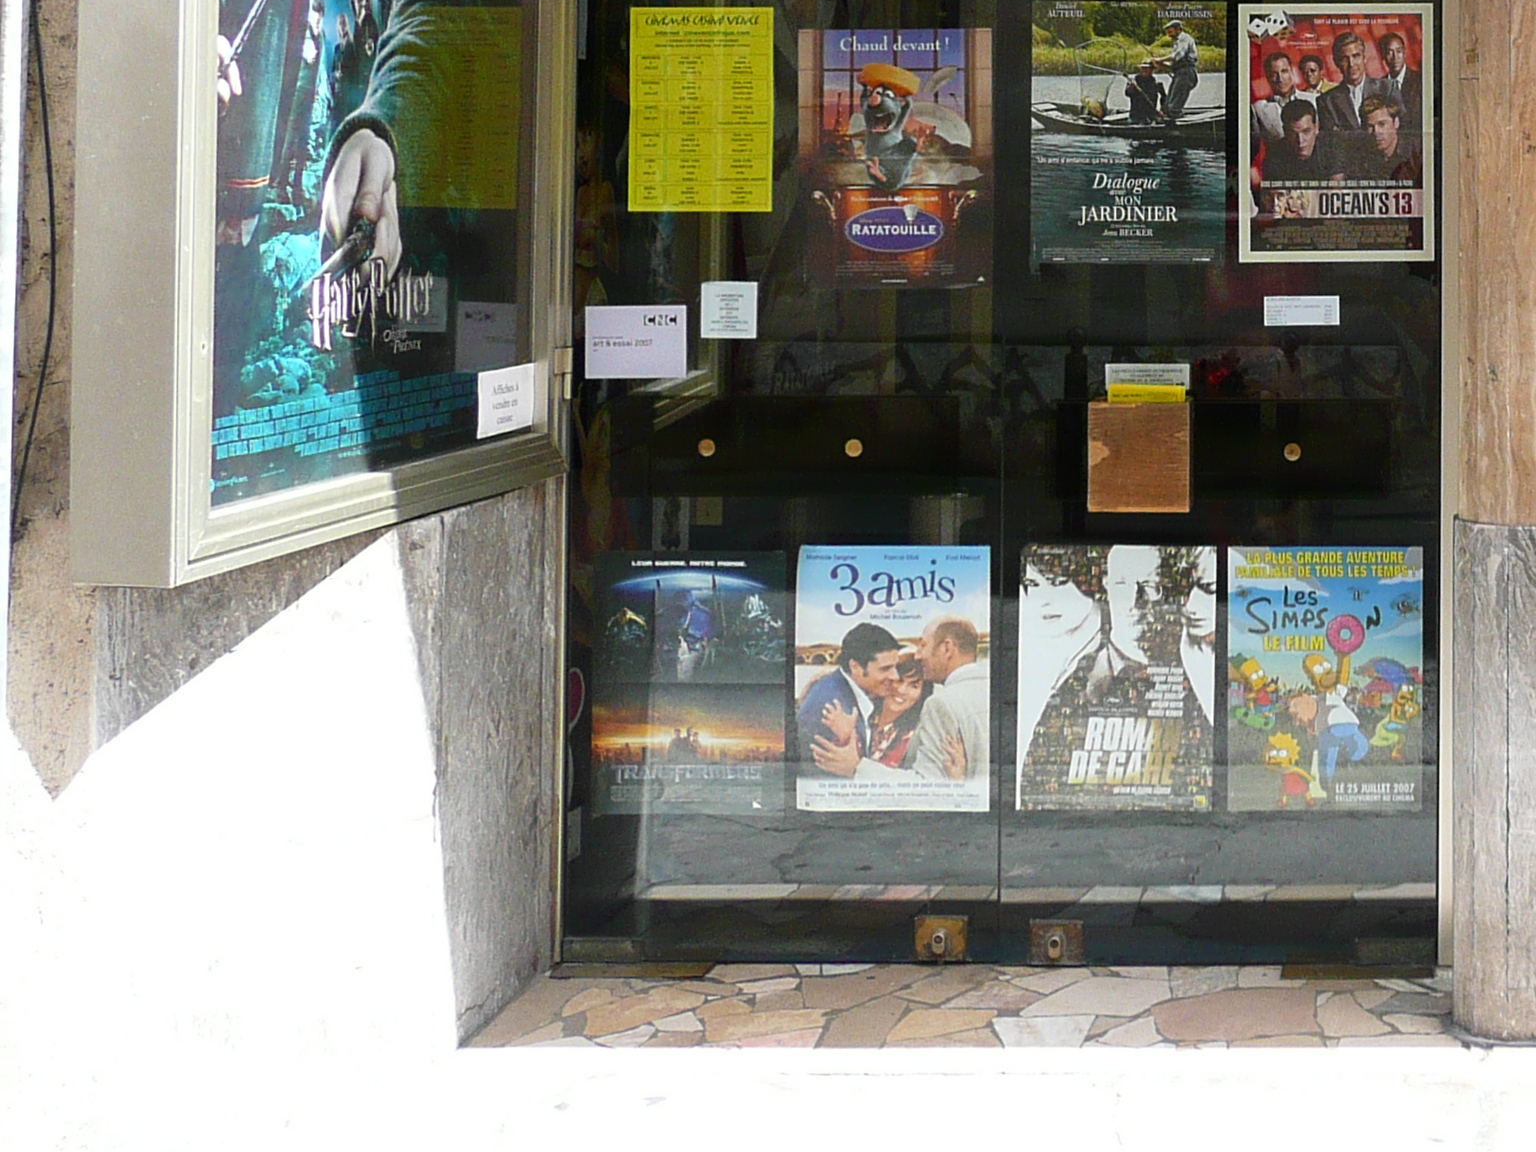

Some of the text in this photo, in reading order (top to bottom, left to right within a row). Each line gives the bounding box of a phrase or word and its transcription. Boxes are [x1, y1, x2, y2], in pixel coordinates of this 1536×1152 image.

[1048, 10, 1086, 18] AUTEUIL
[839, 35, 888, 52] Chaud
[893, 35, 941, 51] devant
[1093, 173, 1161, 194] Dialogue
[1115, 196, 1142, 206] MON
[1319, 192, 1412, 216] OCEAN'S 13
[1078, 206, 1179, 226] JARDINIER
[851, 222, 937, 236] RATATOUILLE
[1246, 551, 1404, 565] LA PLUS GRANDE AVENTURE
[1298, 566, 1311, 578] DE
[1315, 566, 1344, 579] TOUS
[1348, 566, 1367, 579] LES
[1372, 566, 1409, 579] TEMPS
[830, 558, 956, 617] 3 amis
[1283, 585, 1318, 608] Les
[1263, 635, 1325, 652] LE FILM
[1084, 716, 1185, 751] ROMAN
[1067, 750, 1177, 785] DE GARE
[1335, 783, 1344, 794] LE
[1361, 783, 1391, 794] JUILLET
[1393, 783, 1415, 794] 2007
